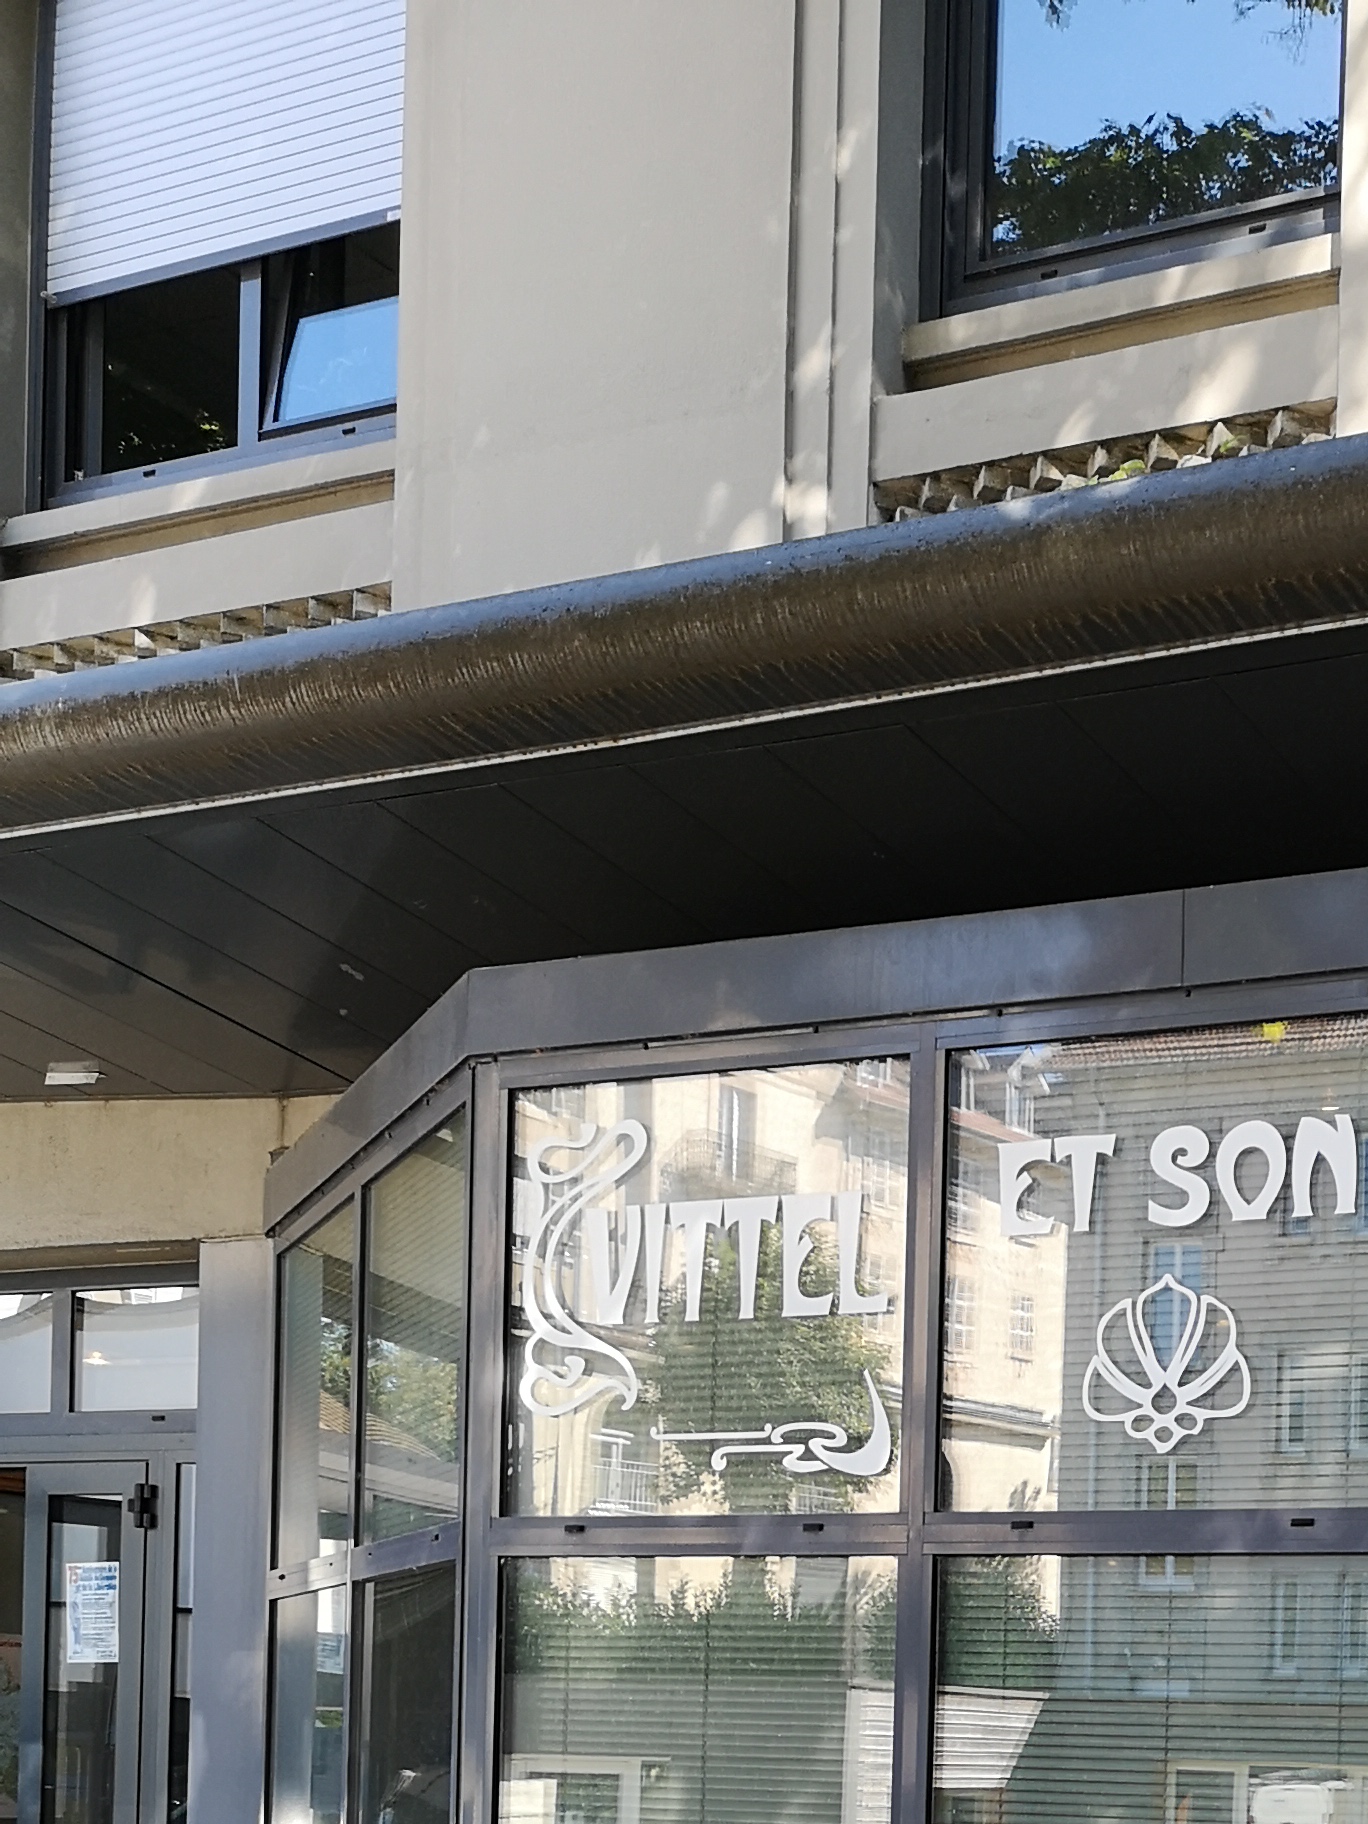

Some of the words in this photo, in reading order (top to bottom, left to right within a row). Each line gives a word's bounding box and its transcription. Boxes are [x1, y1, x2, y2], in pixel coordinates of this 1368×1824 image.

[586, 1190, 888, 1325] VITTEL
[997, 1133, 1117, 1237] ET
[1147, 1113, 1357, 1228] SON
